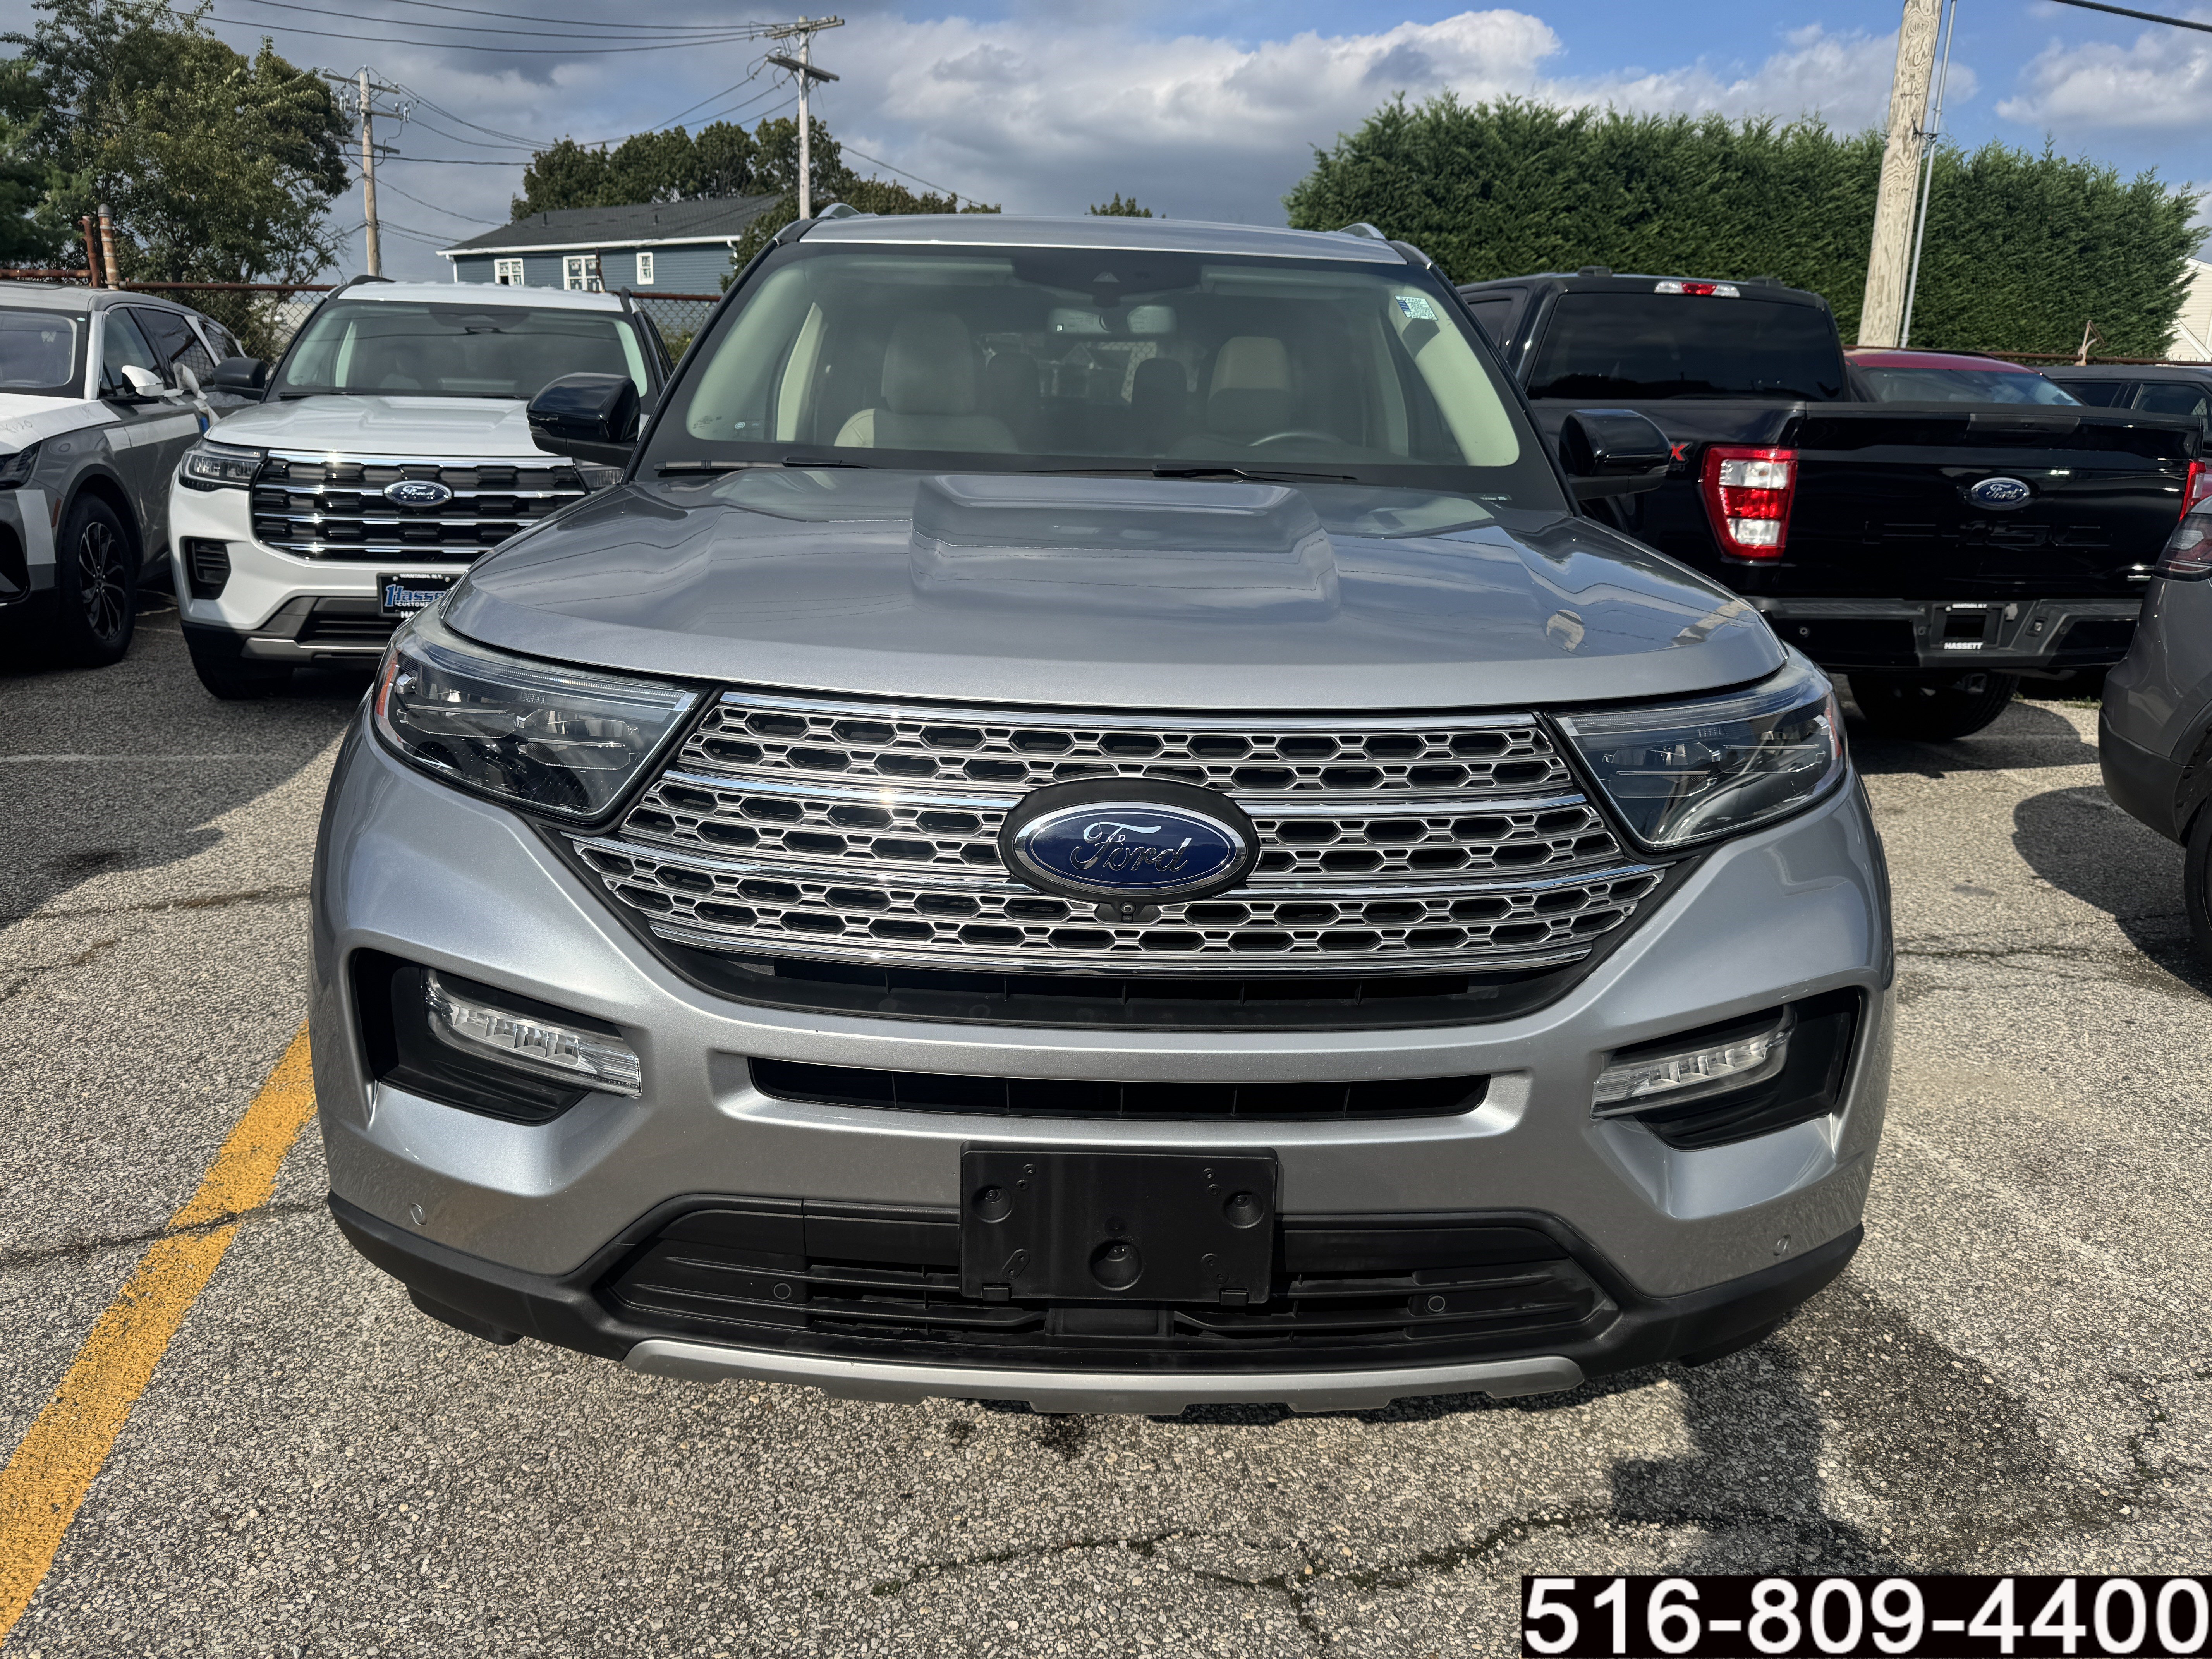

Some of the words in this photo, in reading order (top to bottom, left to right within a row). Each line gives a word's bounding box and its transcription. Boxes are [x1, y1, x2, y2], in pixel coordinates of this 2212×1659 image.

[400, 484, 436, 500] Ford
[1986, 483, 2018, 500] Ford
[384, 584, 446, 607] Hasse
[1943, 642, 1984, 650] HASSETT
[1070, 821, 1192, 872] Ford
